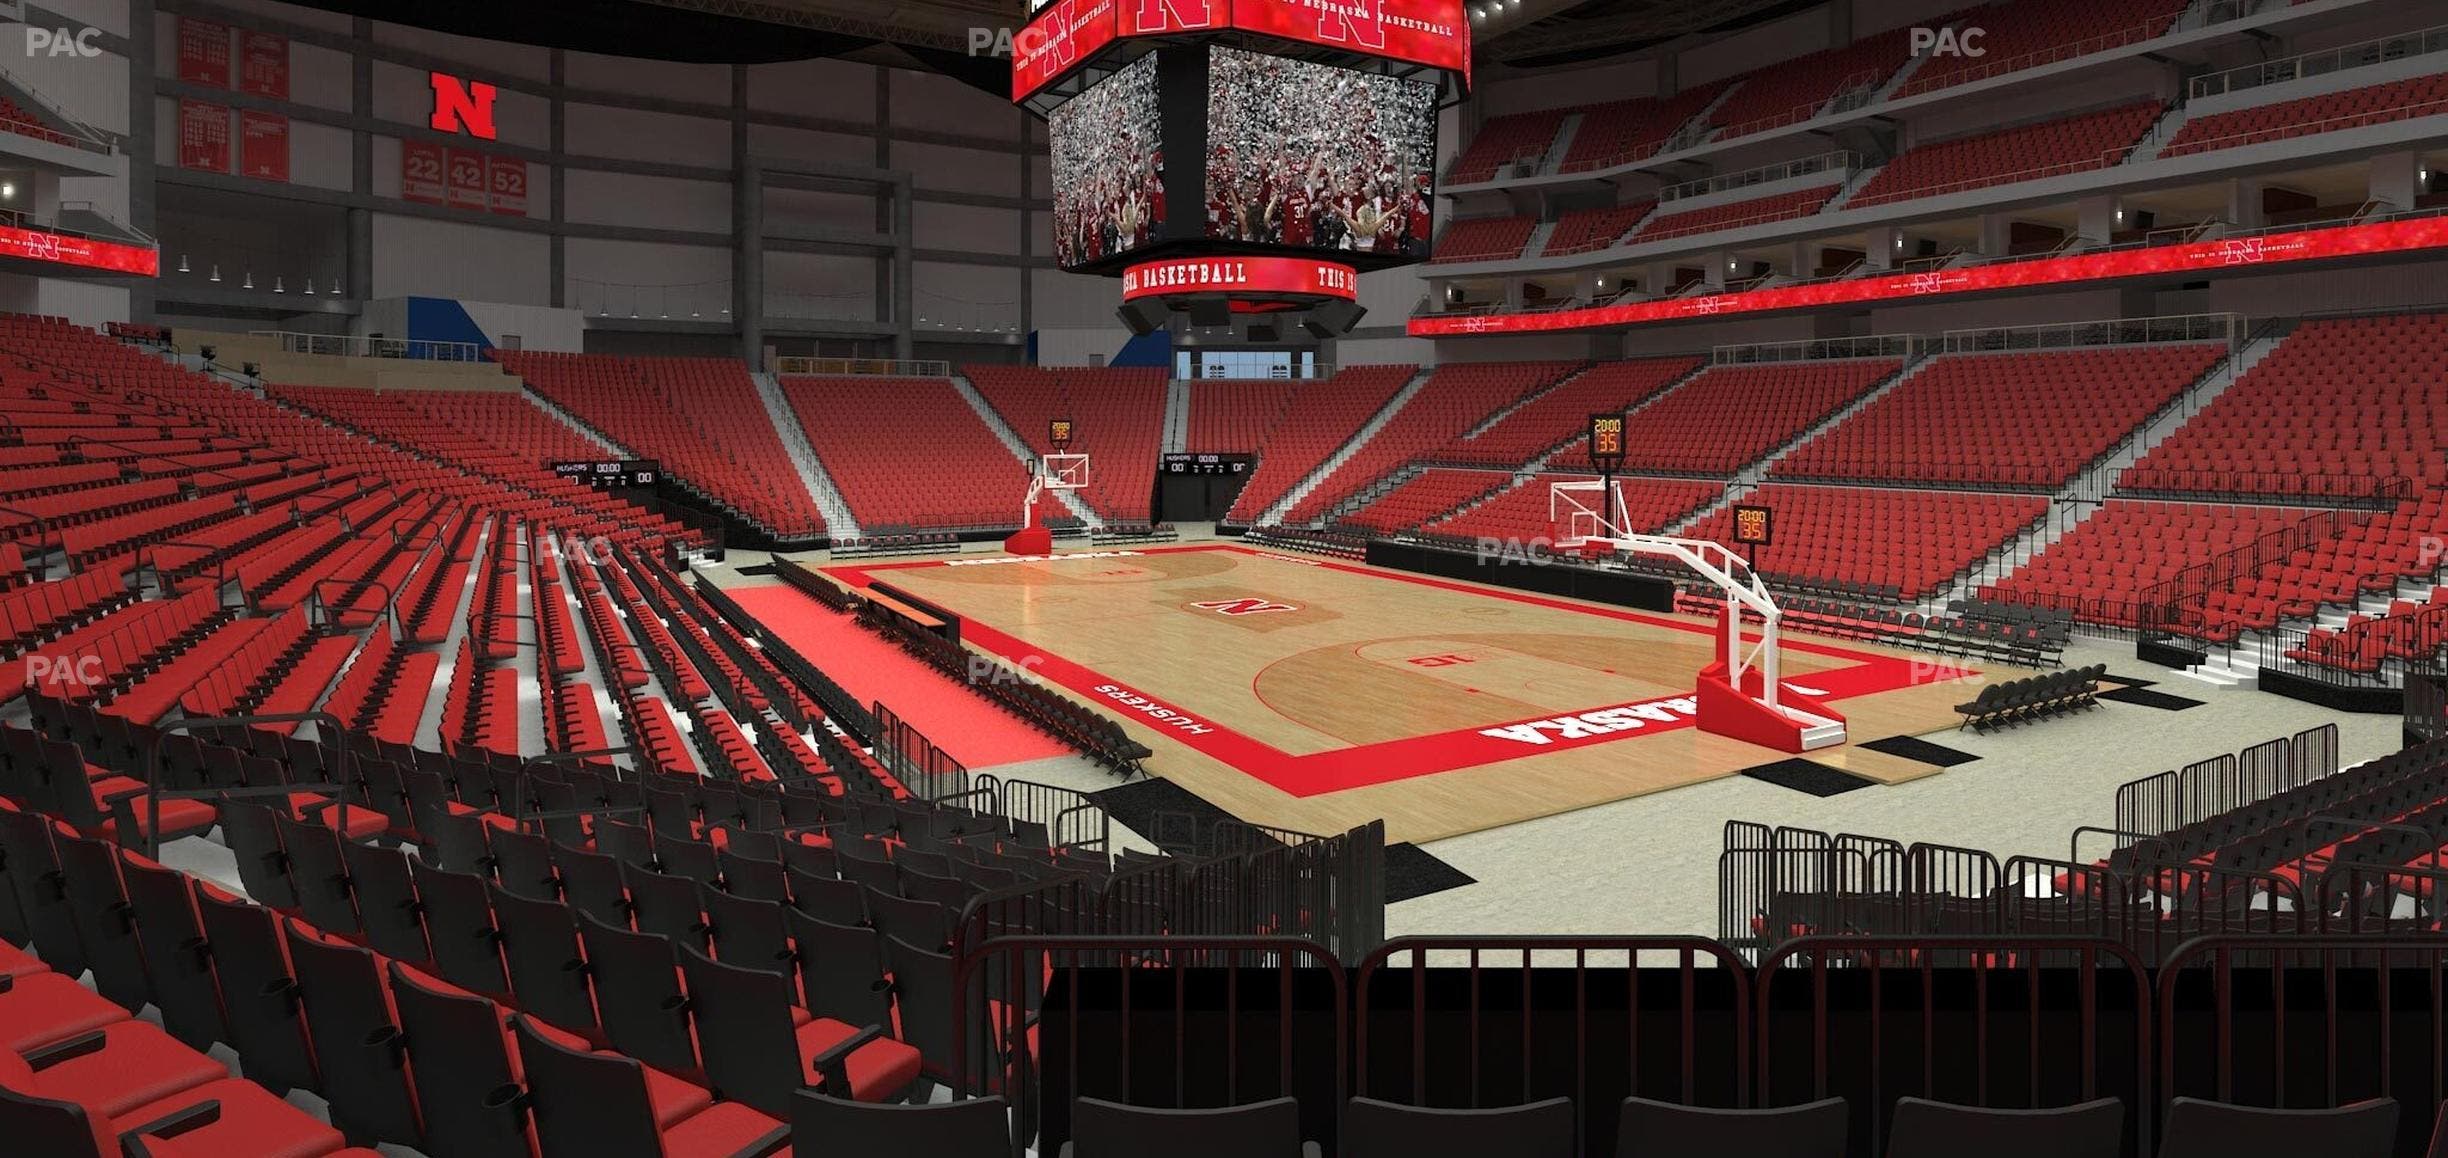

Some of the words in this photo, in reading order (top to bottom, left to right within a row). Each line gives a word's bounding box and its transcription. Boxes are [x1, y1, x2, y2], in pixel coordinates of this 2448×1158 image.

[1378, 12, 1453, 36] BASKETBALL
[429, 70, 498, 141] N
[408, 156, 440, 180] 22
[451, 164, 481, 187] 42
[495, 171, 522, 193] 52
[28, 232, 60, 260] N
[2226, 238, 2264, 264] N
[1143, 263, 1246, 287] BASKETBALL
[1318, 266, 1344, 286] THIS
[1914, 272, 1940, 294] N
[1056, 430, 1068, 440] 35
[1594, 419, 1621, 432] 20:00
[1599, 434, 1616, 452] 35
[638, 472, 652, 483] 00
[1172, 463, 1184, 472] 00
[1738, 510, 1766, 522] 20:00
[1744, 523, 1760, 538] 35
[1094, 684, 1214, 735] HUSKERS
